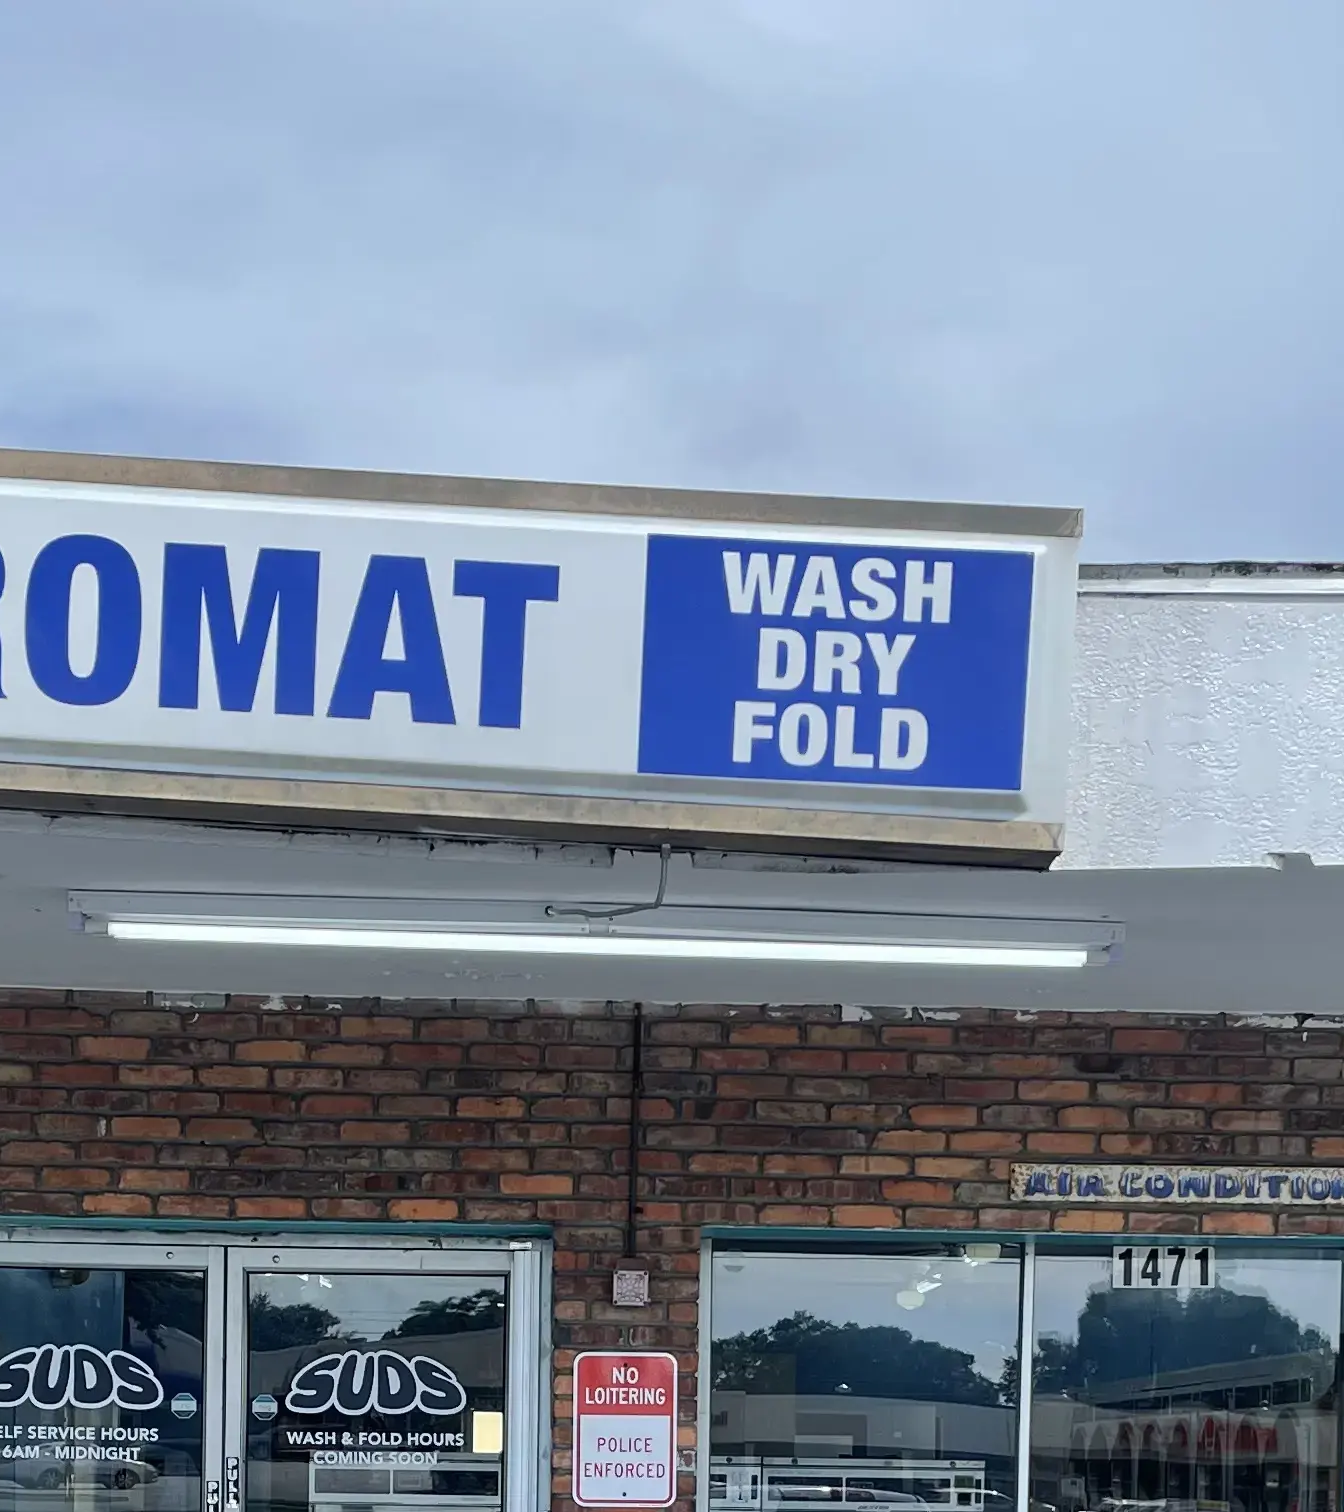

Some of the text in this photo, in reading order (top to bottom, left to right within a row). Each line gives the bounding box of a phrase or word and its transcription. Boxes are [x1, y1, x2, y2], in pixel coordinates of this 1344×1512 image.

[722, 551, 953, 624] WASH
[757, 628, 917, 696] DRY
[733, 703, 929, 772] FOLD
[1024, 1170, 1106, 1197] AIR
[1117, 1247, 1210, 1287] 1471
[285, 1350, 467, 1416] SUDS
[611, 1366, 639, 1385] NO
[584, 1386, 667, 1406] LOITERING
[27, 1425, 96, 1441] SERVICE
[100, 1427, 159, 1442] HOURS
[286, 1431, 465, 1447] WASH & FOLD HOURS
[1, 1444, 40, 1459] 6AM
[54, 1445, 141, 1462] MIDNIGHT
[596, 1437, 654, 1453] POLICE
[312, 1450, 438, 1465] COMING SOON
[583, 1462, 666, 1479] ENFORCED
